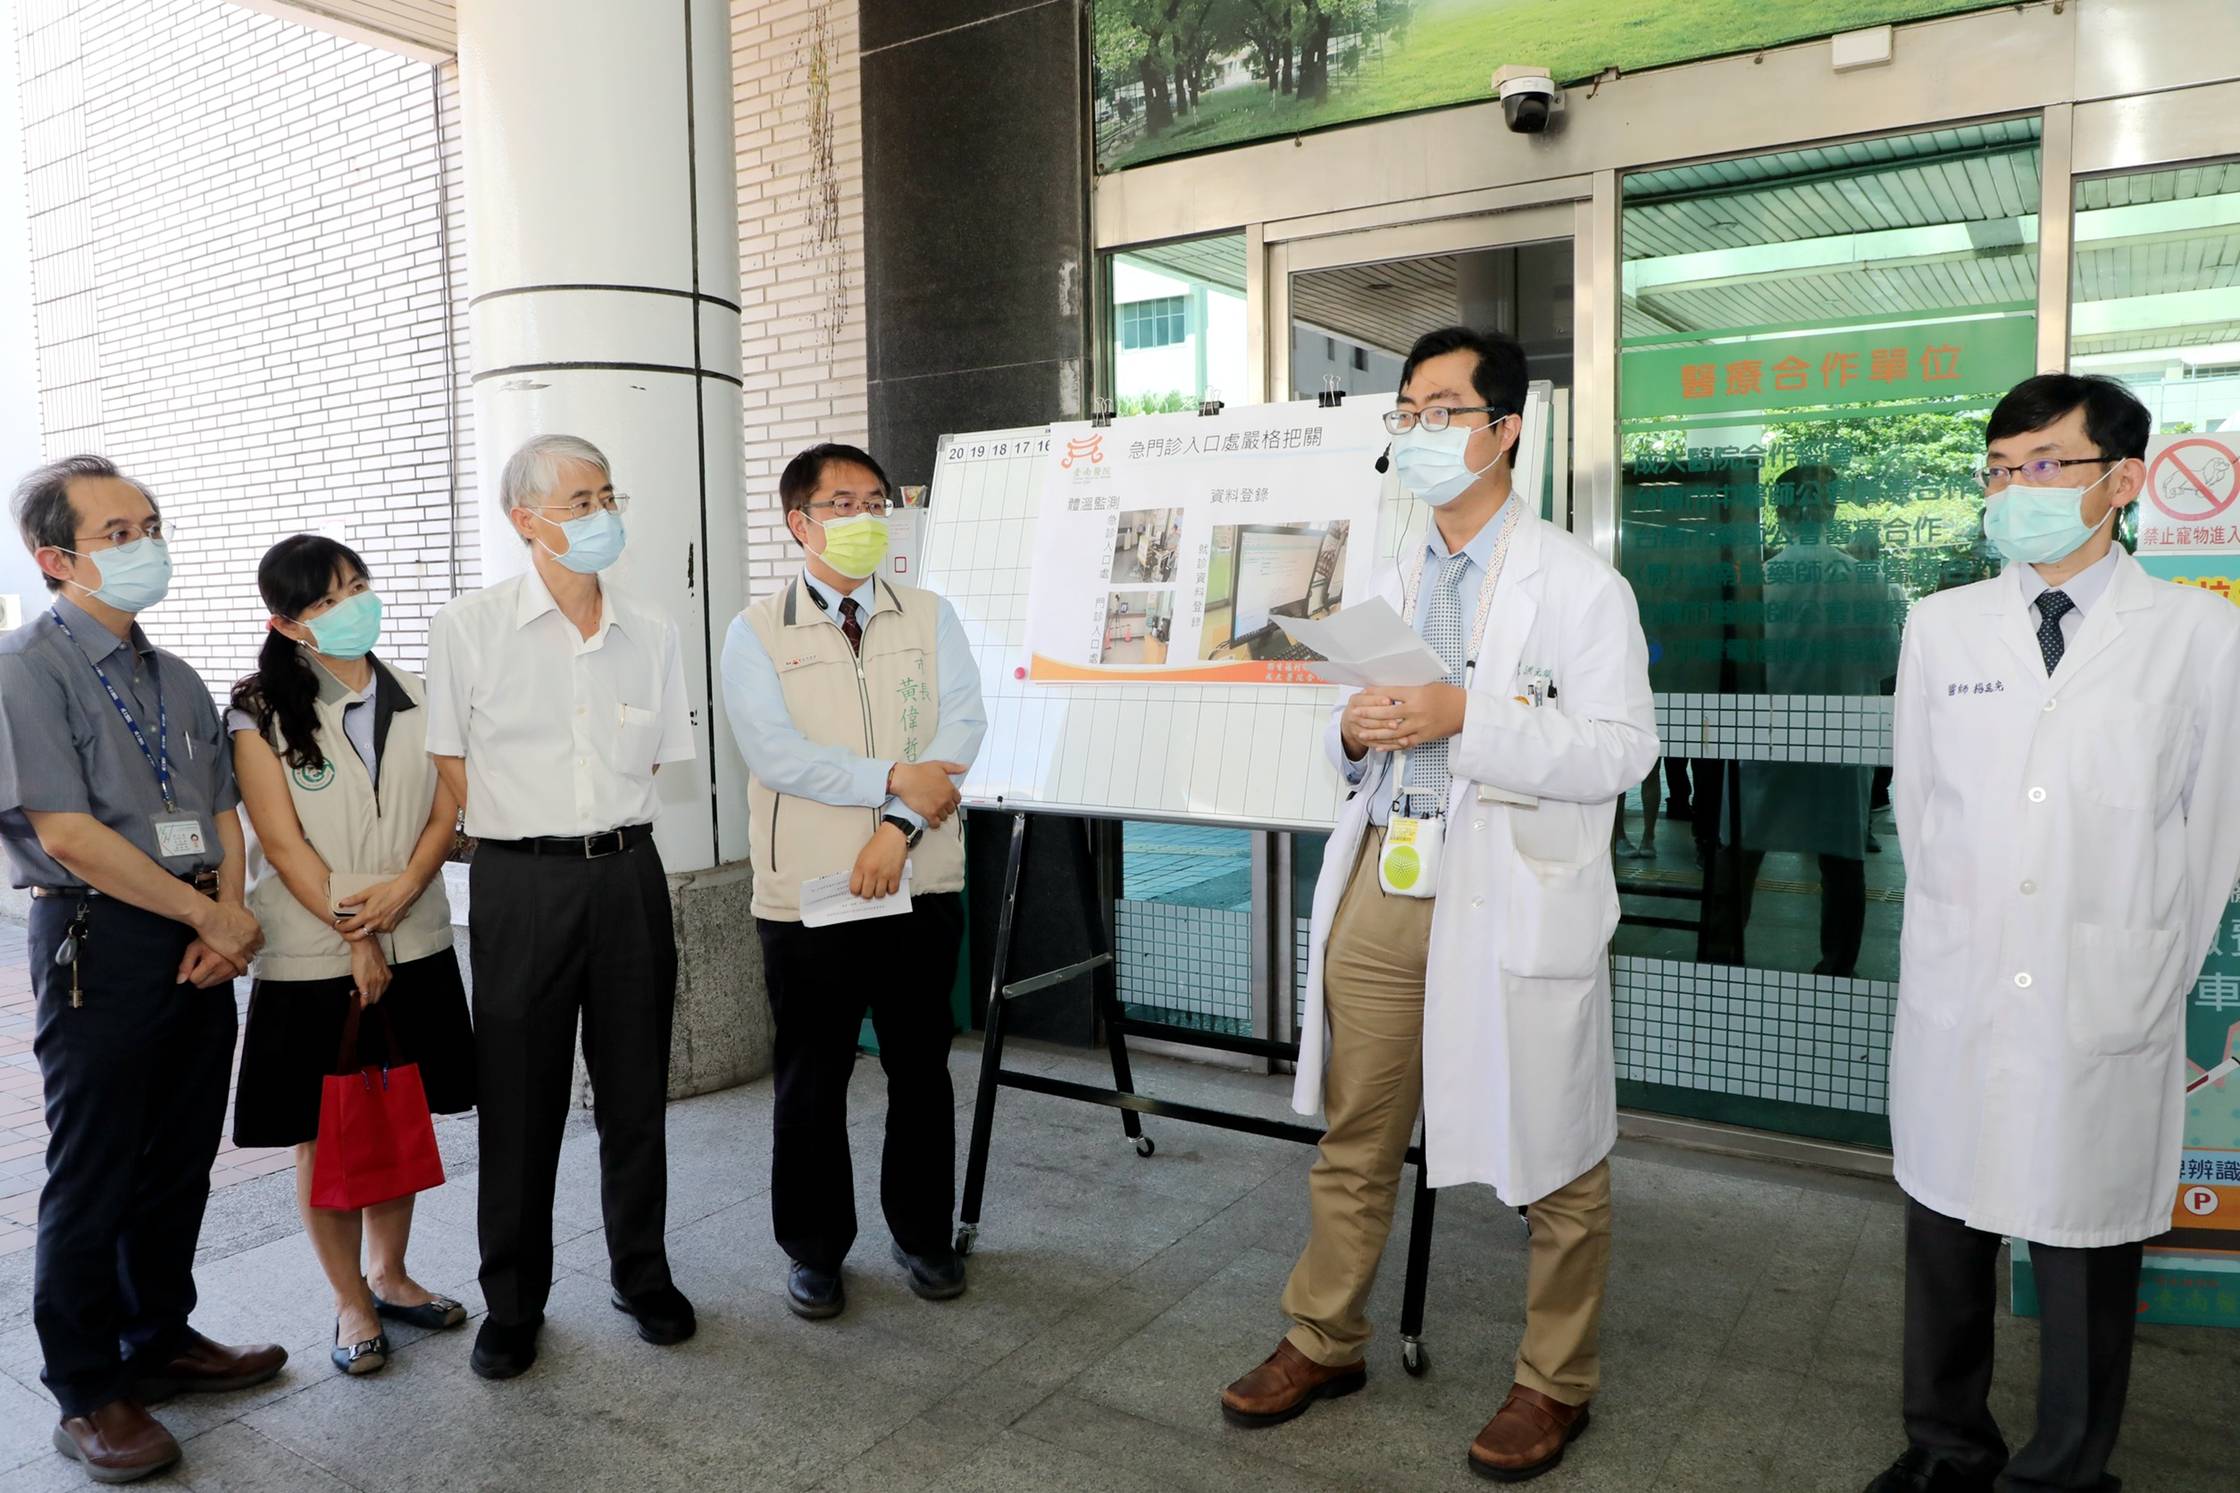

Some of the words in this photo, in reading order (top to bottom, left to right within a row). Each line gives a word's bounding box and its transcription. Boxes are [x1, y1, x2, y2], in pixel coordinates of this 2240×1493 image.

[1681, 344, 1963, 399] 醫療合作單位
[949, 447, 964, 460] 20
[970, 446, 985, 457] 19
[992, 443, 1007, 456] 18
[1014, 441, 1030, 454] 17
[1128, 426, 1323, 460] 急門診入口處嚴格把關
[1067, 496, 1120, 511] 體溫監測
[1210, 487, 1270, 504] 資料登錄
[2143, 525, 2240, 546] 禁止寵物進入
[896, 677, 920, 763] 黃偉哲
[2193, 1192, 2211, 1210] P
